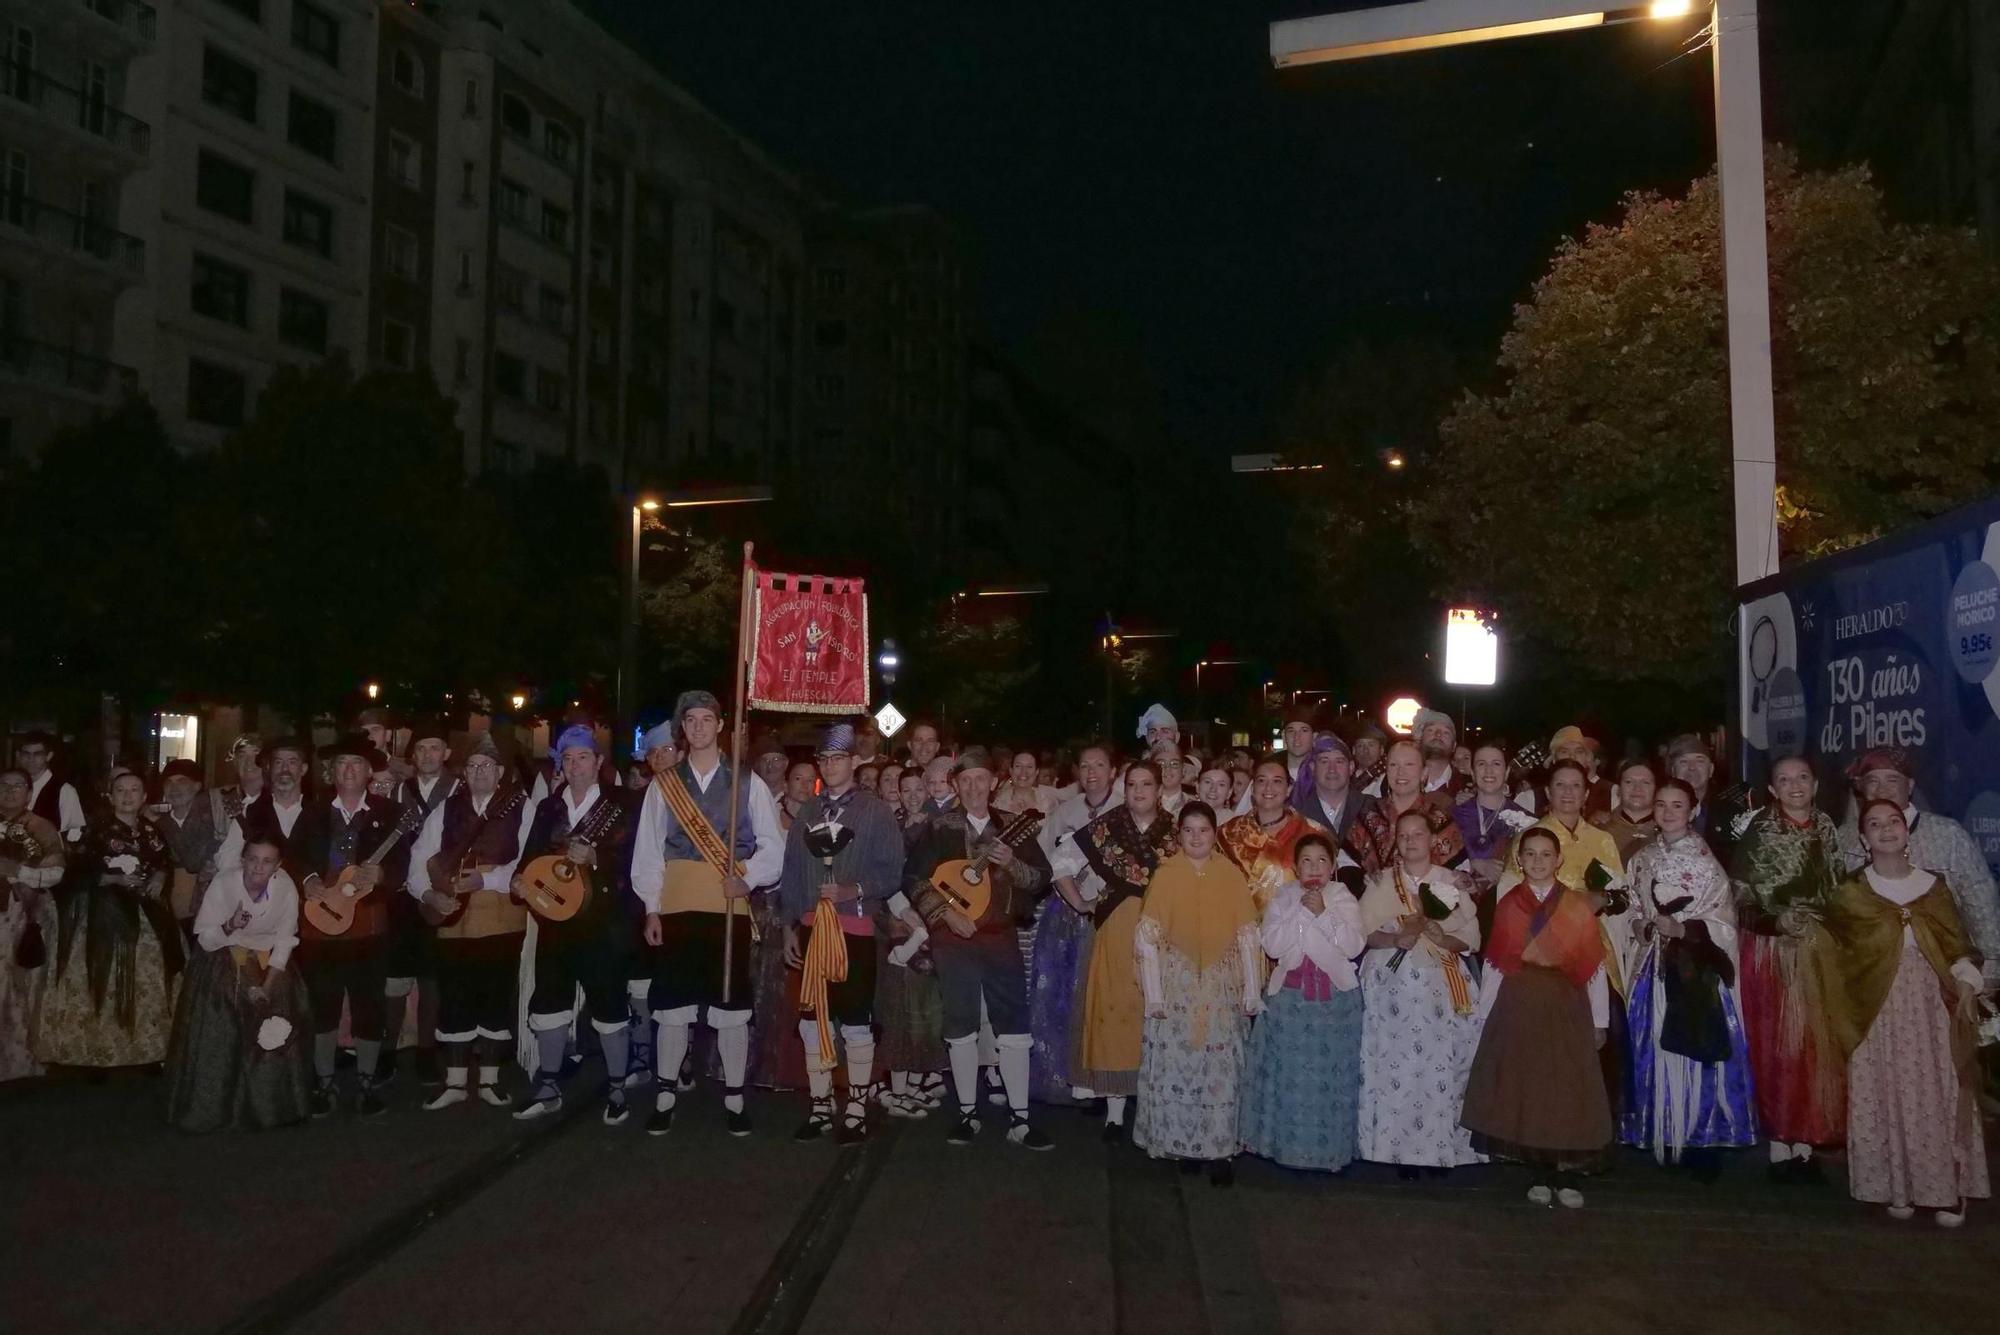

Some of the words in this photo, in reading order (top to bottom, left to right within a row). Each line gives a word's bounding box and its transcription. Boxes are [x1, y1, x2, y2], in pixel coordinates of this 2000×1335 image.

[1954, 587, 1998, 611] PELUCHE
[1836, 606, 1893, 640] HERALDO
[777, 631, 796, 648] SAN
[827, 635, 855, 661] ISIDRO
[782, 669, 795, 682] EL
[800, 669, 837, 685] TEMPLE
[1827, 656, 1864, 704] 130
[1871, 655, 1920, 699] años
[881, 714, 896, 726] 30
[1820, 705, 1843, 753] de
[1850, 701, 1926, 750] Pilares
